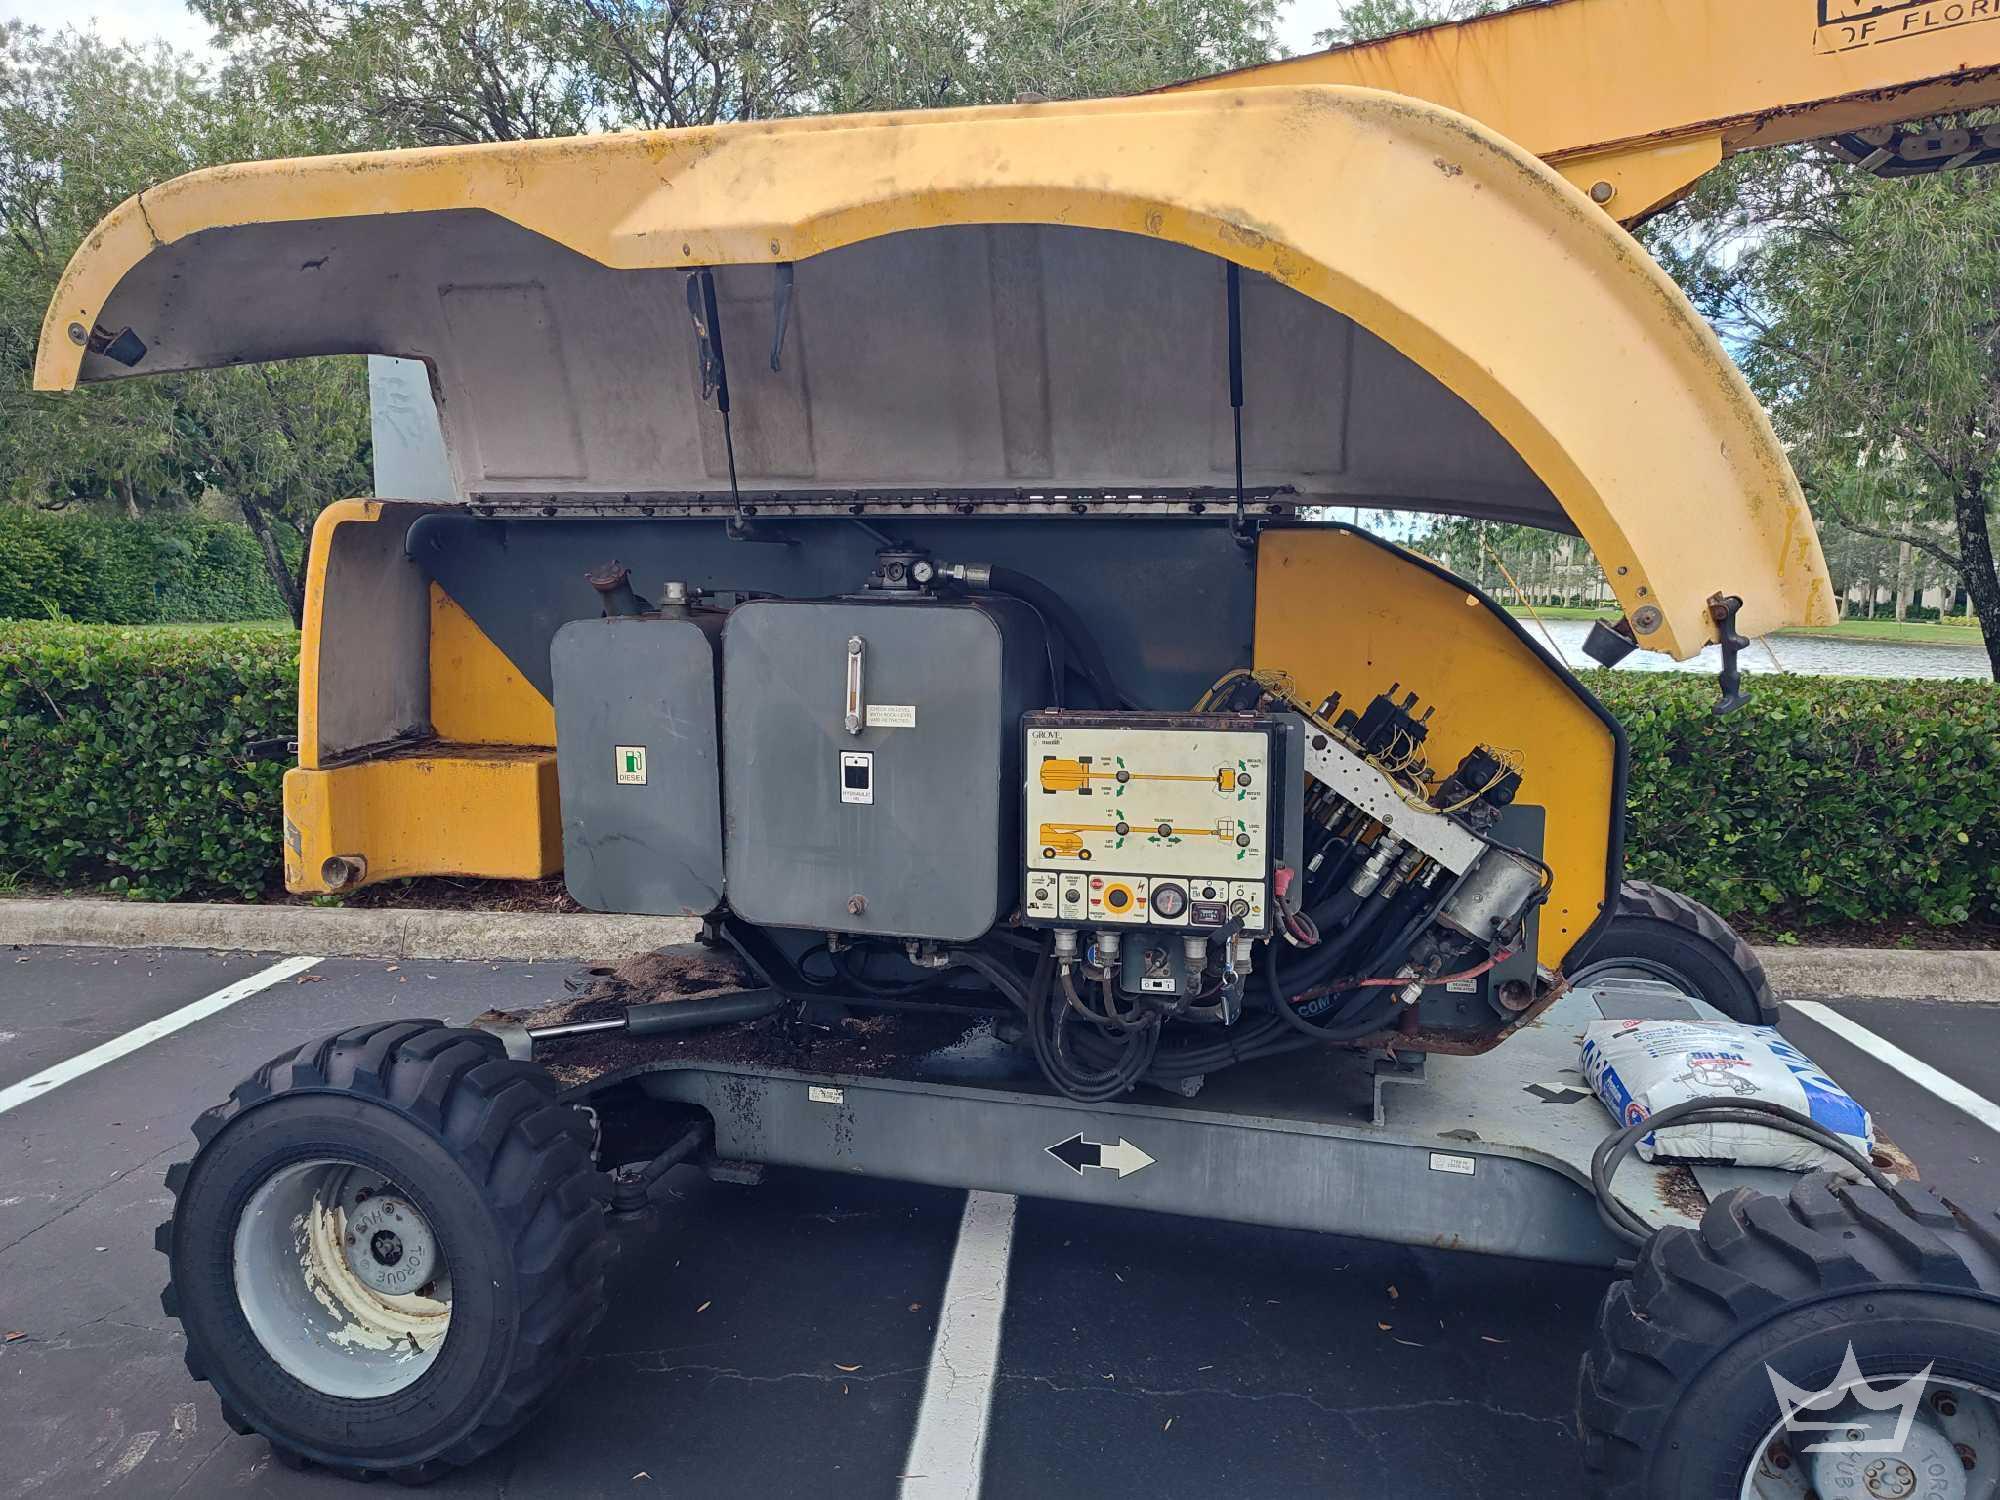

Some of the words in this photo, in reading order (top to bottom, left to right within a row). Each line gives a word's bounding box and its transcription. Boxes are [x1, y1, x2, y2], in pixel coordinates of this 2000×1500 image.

[1032, 731, 1058, 739] GROVE
[619, 774, 645, 782] DIESEL
[1691, 1051, 1744, 1061] Oil-Dri
[376, 1245, 425, 1285] TORQUE
